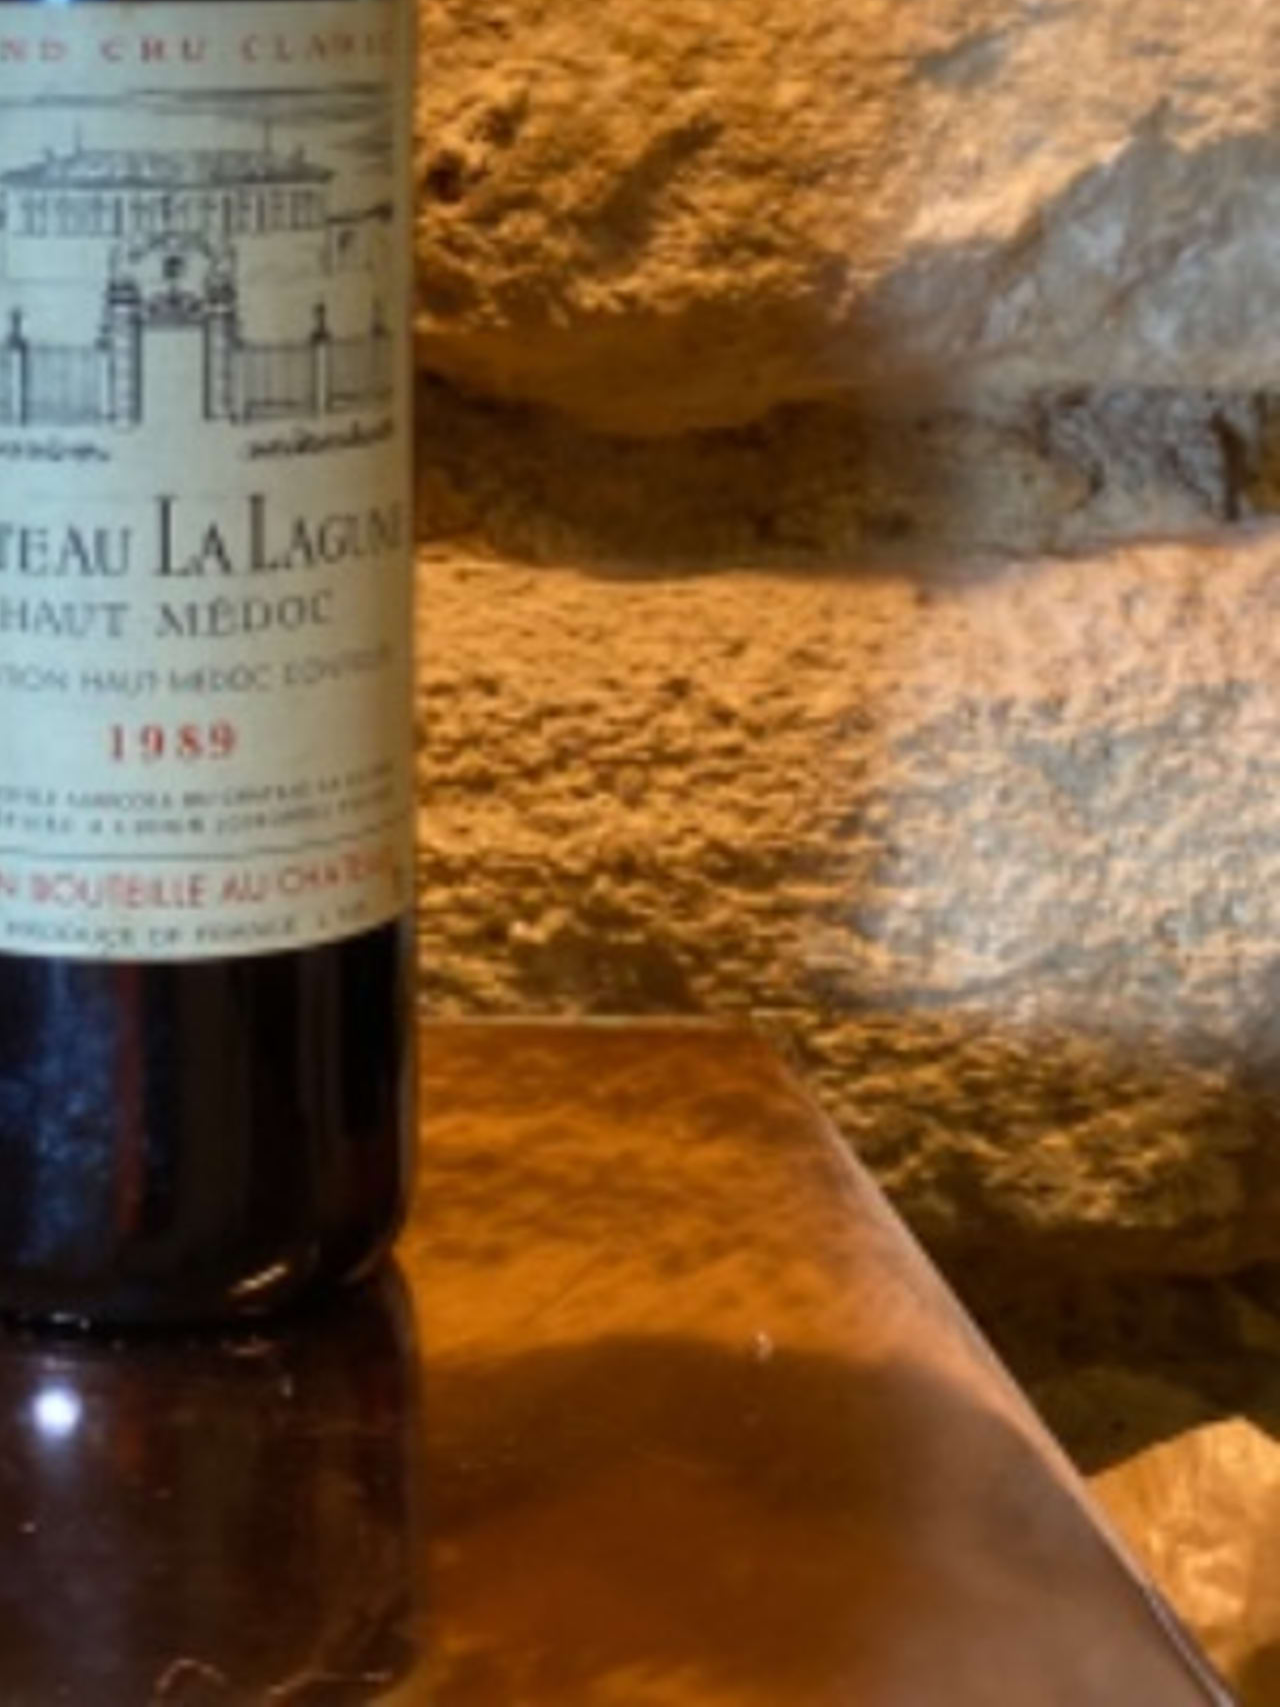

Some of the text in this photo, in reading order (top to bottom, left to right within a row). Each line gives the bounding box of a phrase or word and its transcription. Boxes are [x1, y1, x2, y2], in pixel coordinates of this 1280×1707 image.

[101, 34, 205, 64] CRU
[153, 493, 232, 577] LA
[247, 492, 410, 573] LAGUN
[110, 719, 237, 762] 1989
[221, 866, 268, 903] AU
